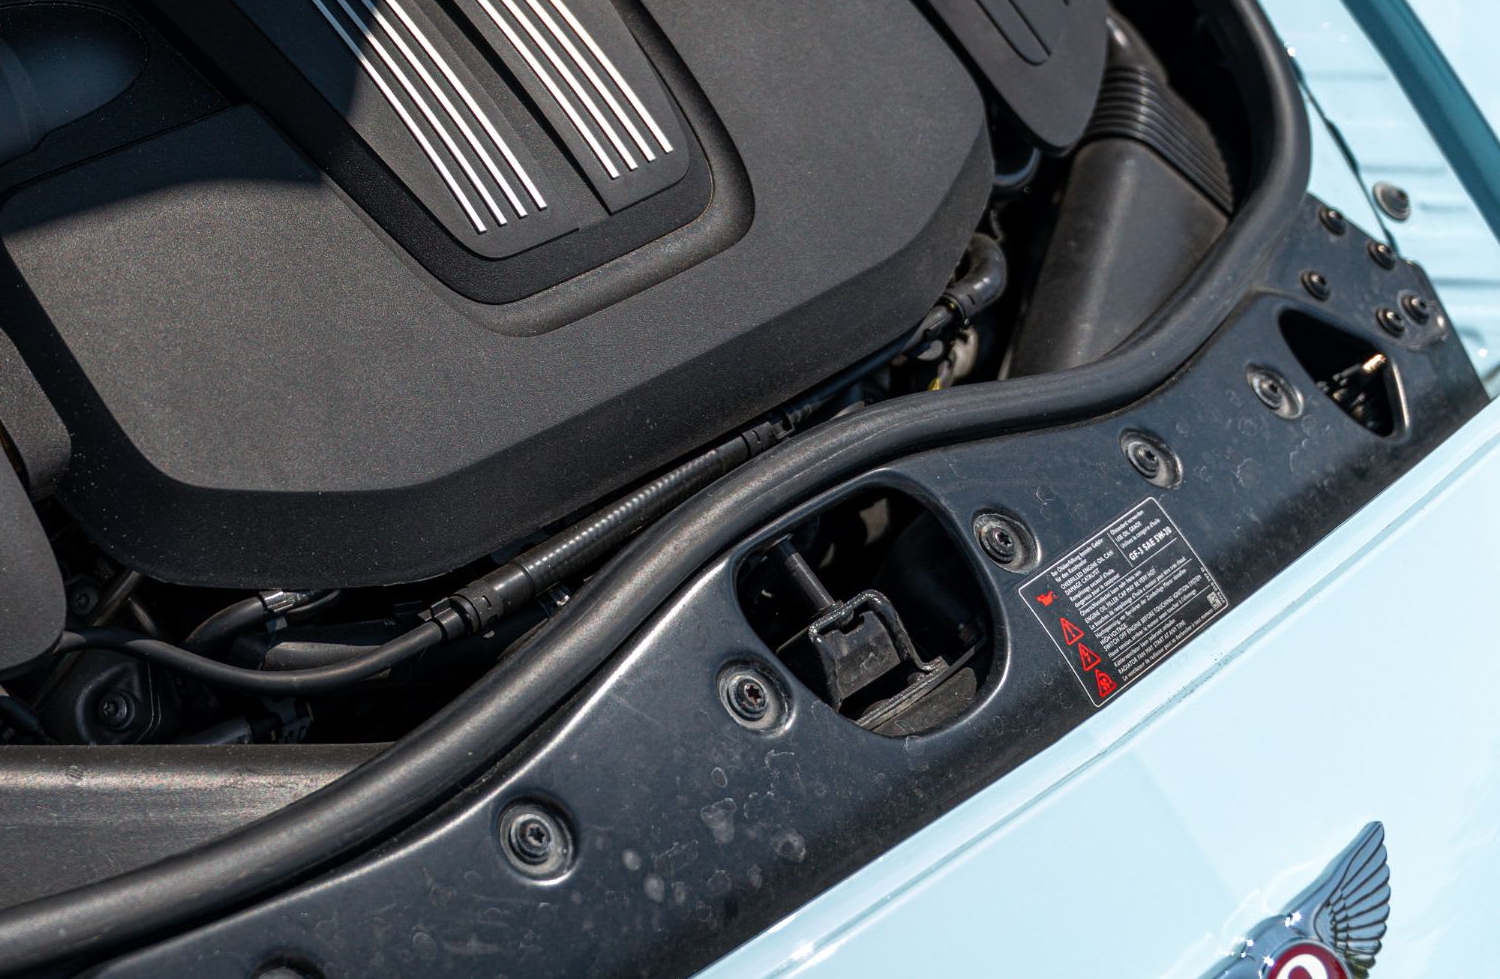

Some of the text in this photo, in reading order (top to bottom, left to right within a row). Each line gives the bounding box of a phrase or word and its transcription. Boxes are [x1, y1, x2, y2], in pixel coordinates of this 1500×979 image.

[1142, 538, 1156, 550] SAE
[1060, 571, 1083, 589] OVERFILLED
[1103, 549, 1113, 558] CAN
[1064, 581, 1082, 595] DAMAGE
[1084, 610, 1100, 623] ENGINE
[1118, 590, 1126, 598] CAP
[1125, 584, 1134, 593] MAY
[1147, 568, 1156, 577] HOT
[1103, 637, 1120, 651] SWITCH
[1118, 657, 1138, 674] RADIATOR
[1137, 651, 1146, 660] FAN
[1153, 636, 1164, 647] START
[1168, 626, 1177, 635] ANY
